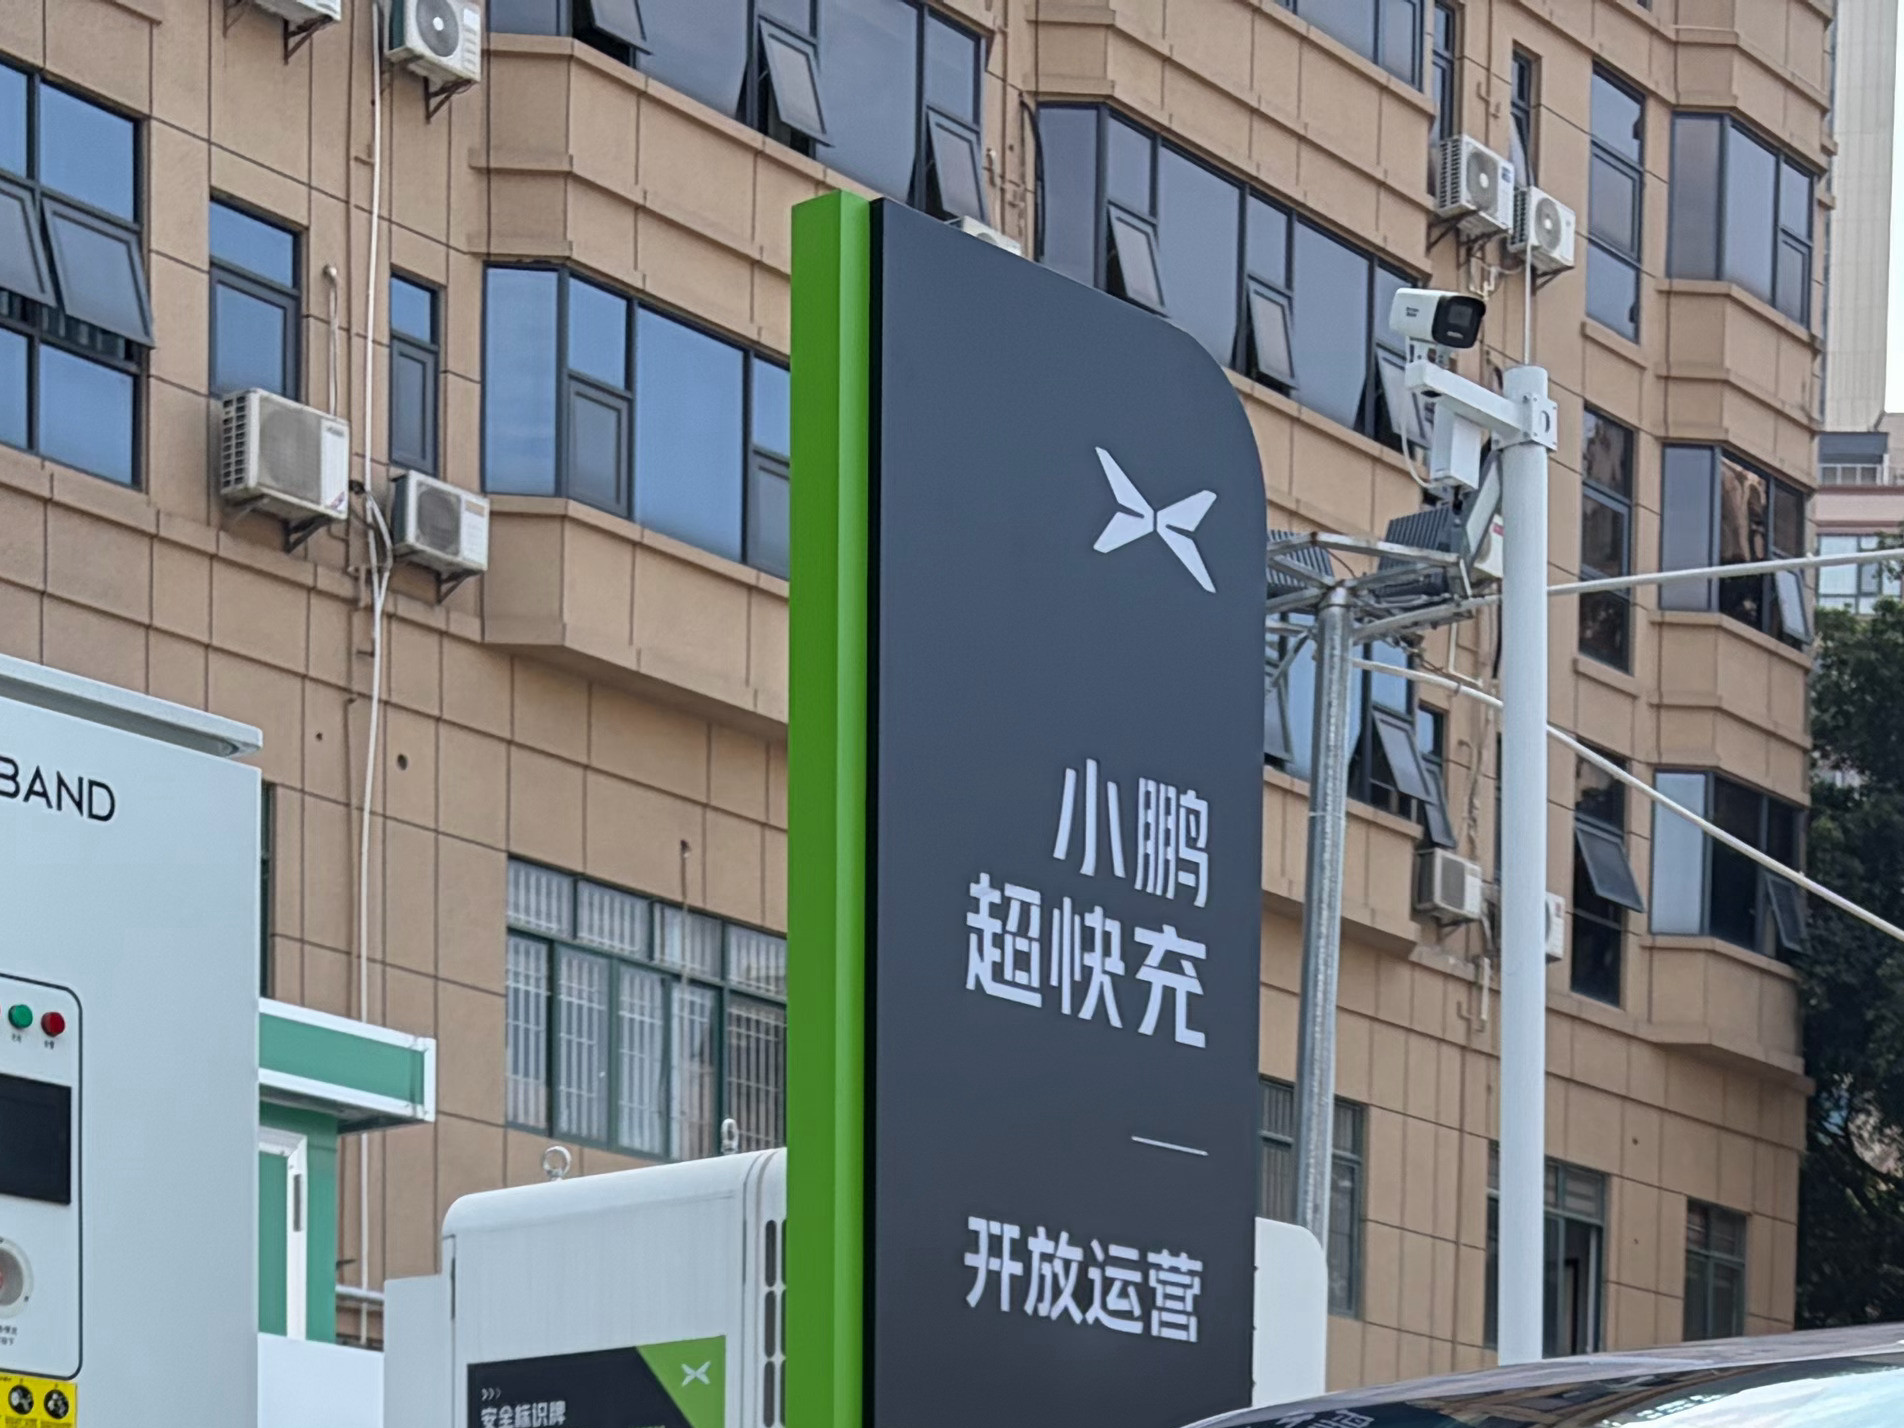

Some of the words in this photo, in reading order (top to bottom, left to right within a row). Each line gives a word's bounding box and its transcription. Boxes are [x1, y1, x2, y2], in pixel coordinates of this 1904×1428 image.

[1052, 758, 1210, 909] 小鹏
[965, 872, 1208, 1048] 超快充
[963, 1215, 1205, 1343] 开放运营
